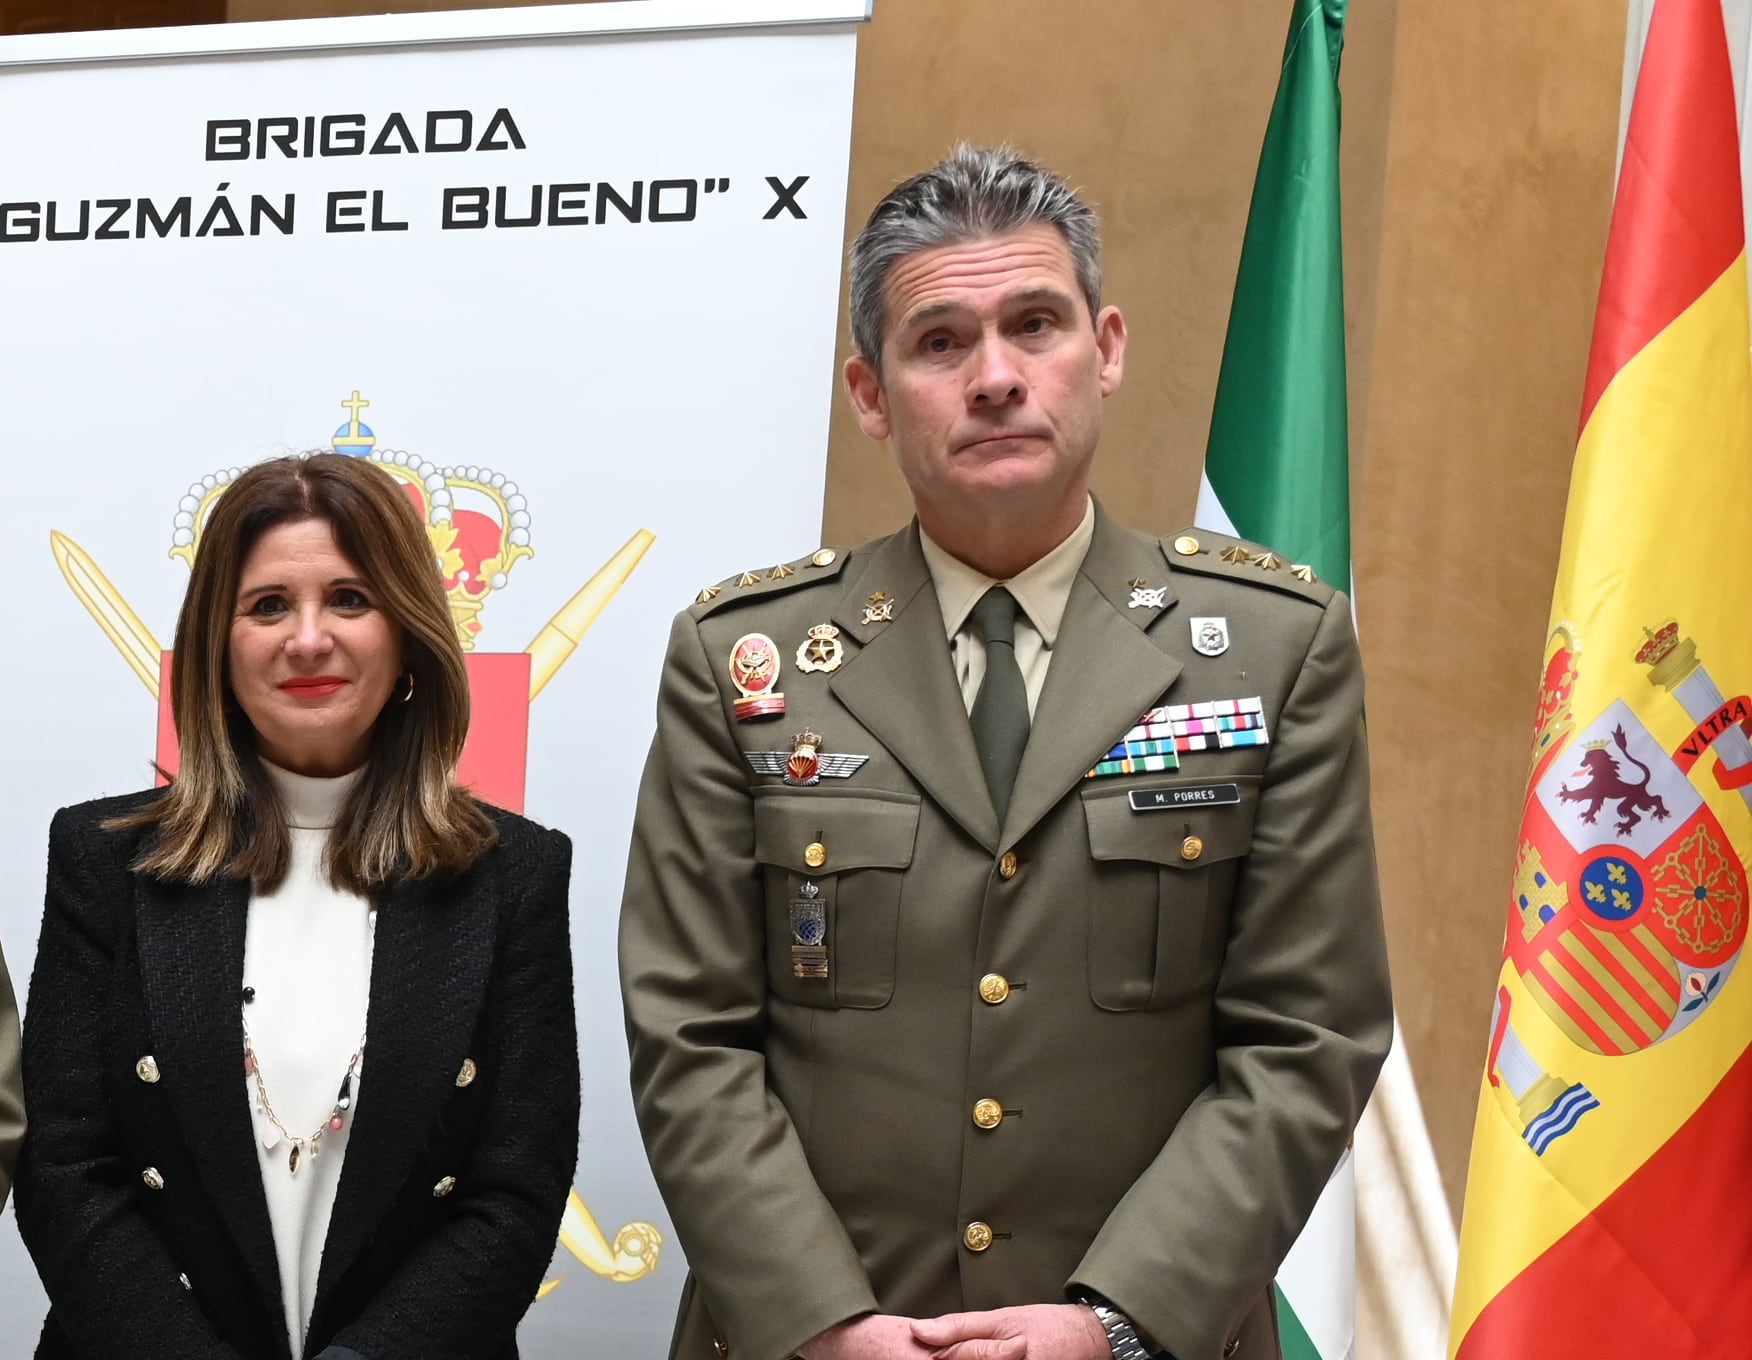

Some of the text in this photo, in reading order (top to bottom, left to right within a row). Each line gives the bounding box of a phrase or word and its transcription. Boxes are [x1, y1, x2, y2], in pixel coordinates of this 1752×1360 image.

[205, 107, 527, 161] BRIGADA
[325, 189, 409, 234] EL
[762, 175, 811, 220] X
[1681, 701, 1748, 756] VLTRA
[1154, 789, 1216, 803] M. PORRES
